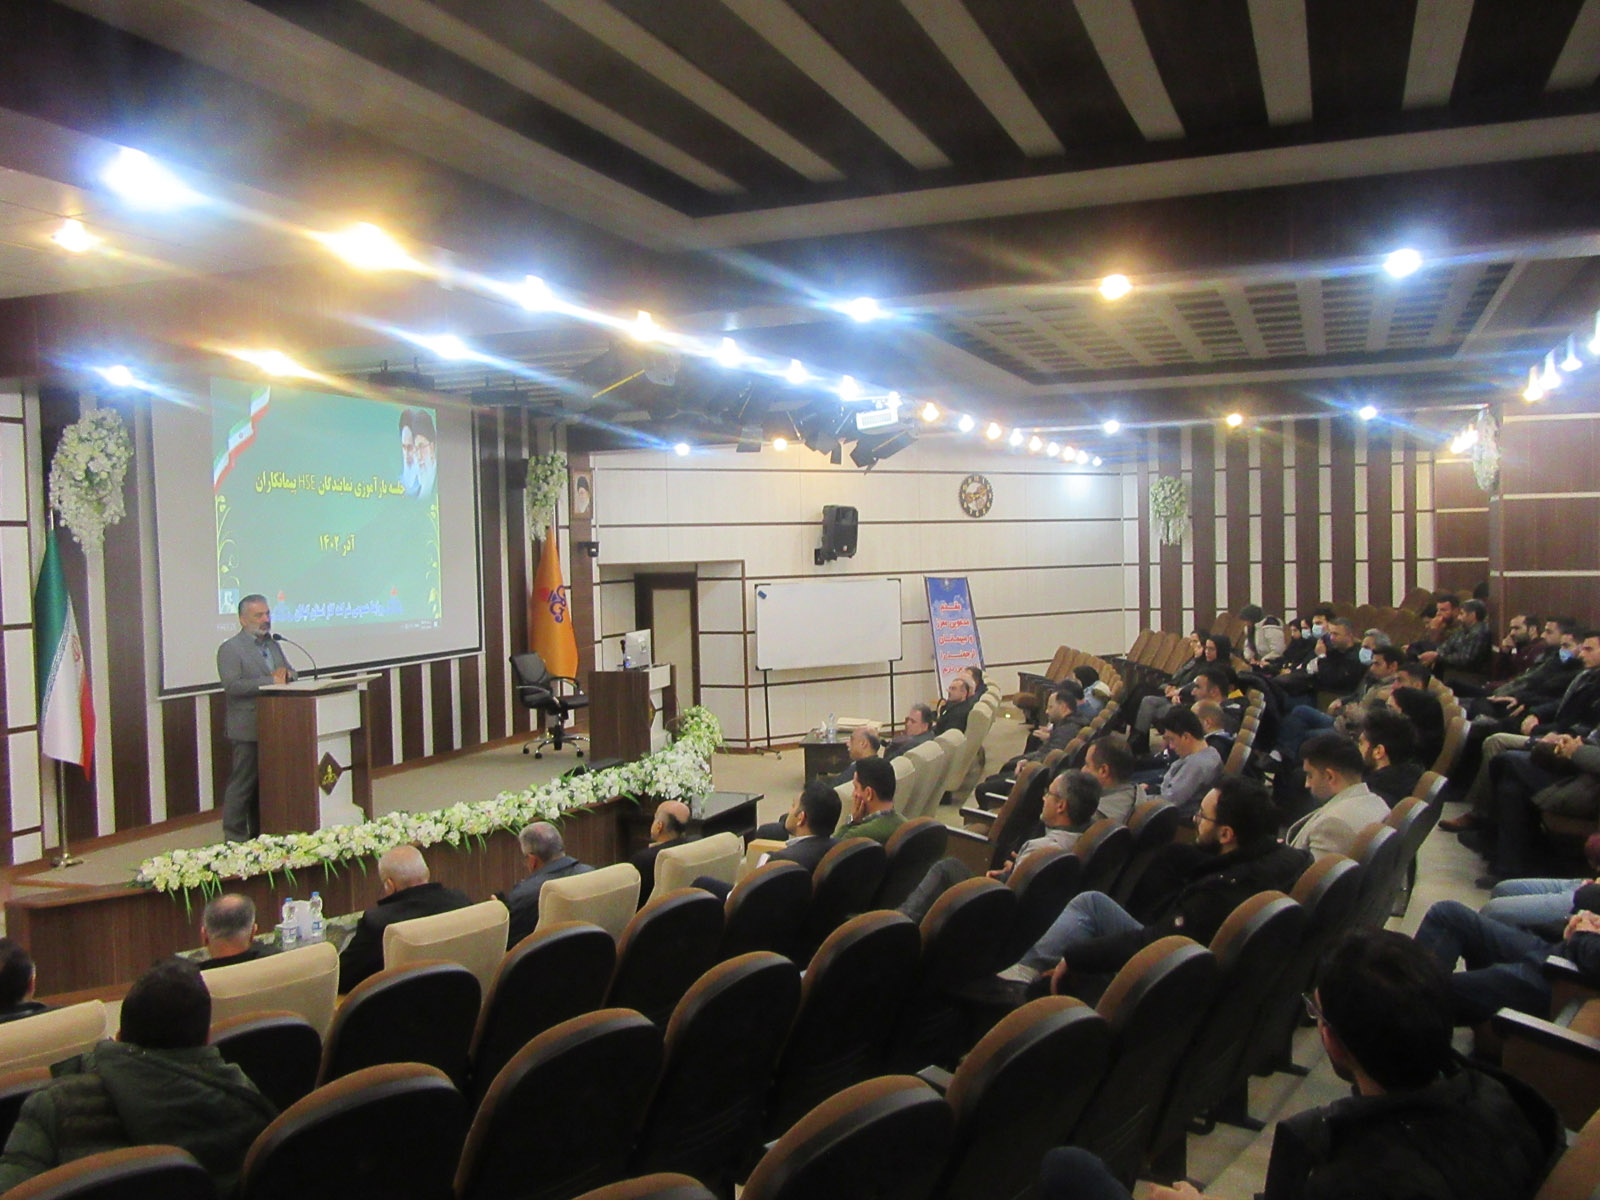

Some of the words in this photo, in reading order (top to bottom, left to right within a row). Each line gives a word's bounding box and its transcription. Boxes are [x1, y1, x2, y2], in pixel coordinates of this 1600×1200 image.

[255, 471, 297, 495] پیمانکاران
[298, 474, 316, 490] HSE
[317, 475, 353, 496] نمایندگان
[388, 480, 406, 498] جلسه
[341, 534, 356, 556] آذر
